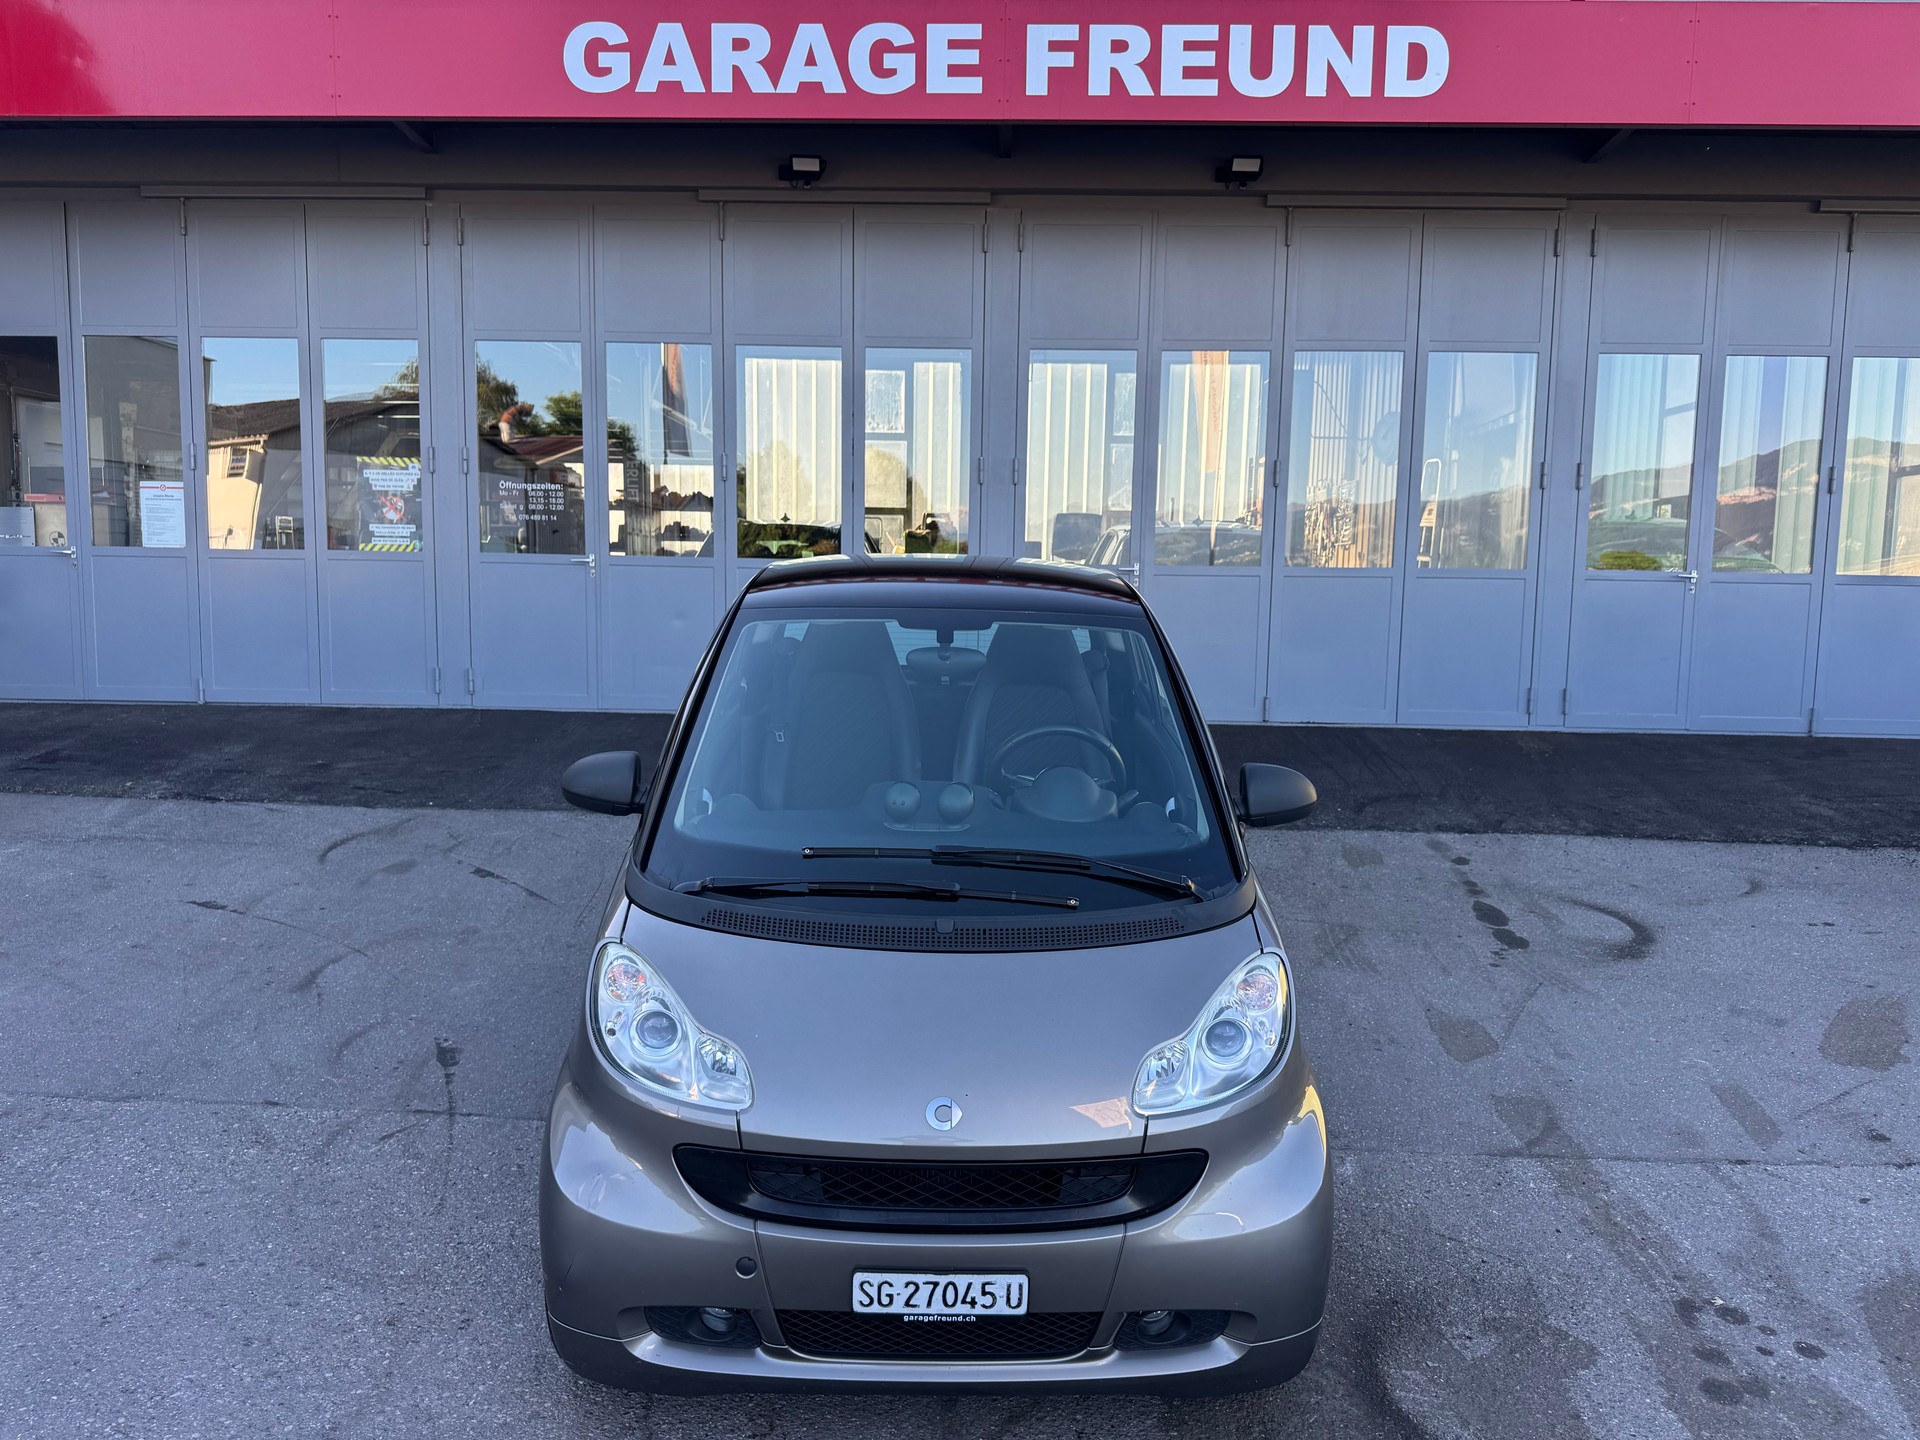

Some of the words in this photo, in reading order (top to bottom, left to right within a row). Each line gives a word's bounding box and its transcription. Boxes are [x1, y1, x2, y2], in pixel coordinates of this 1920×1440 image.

[563, 21, 982, 94] GARAGE
[1025, 24, 1450, 98] FREUND
[499, 480, 563, 491] Öffnungszeiten:
[903, 1314, 977, 1323] garagefreund.ch
